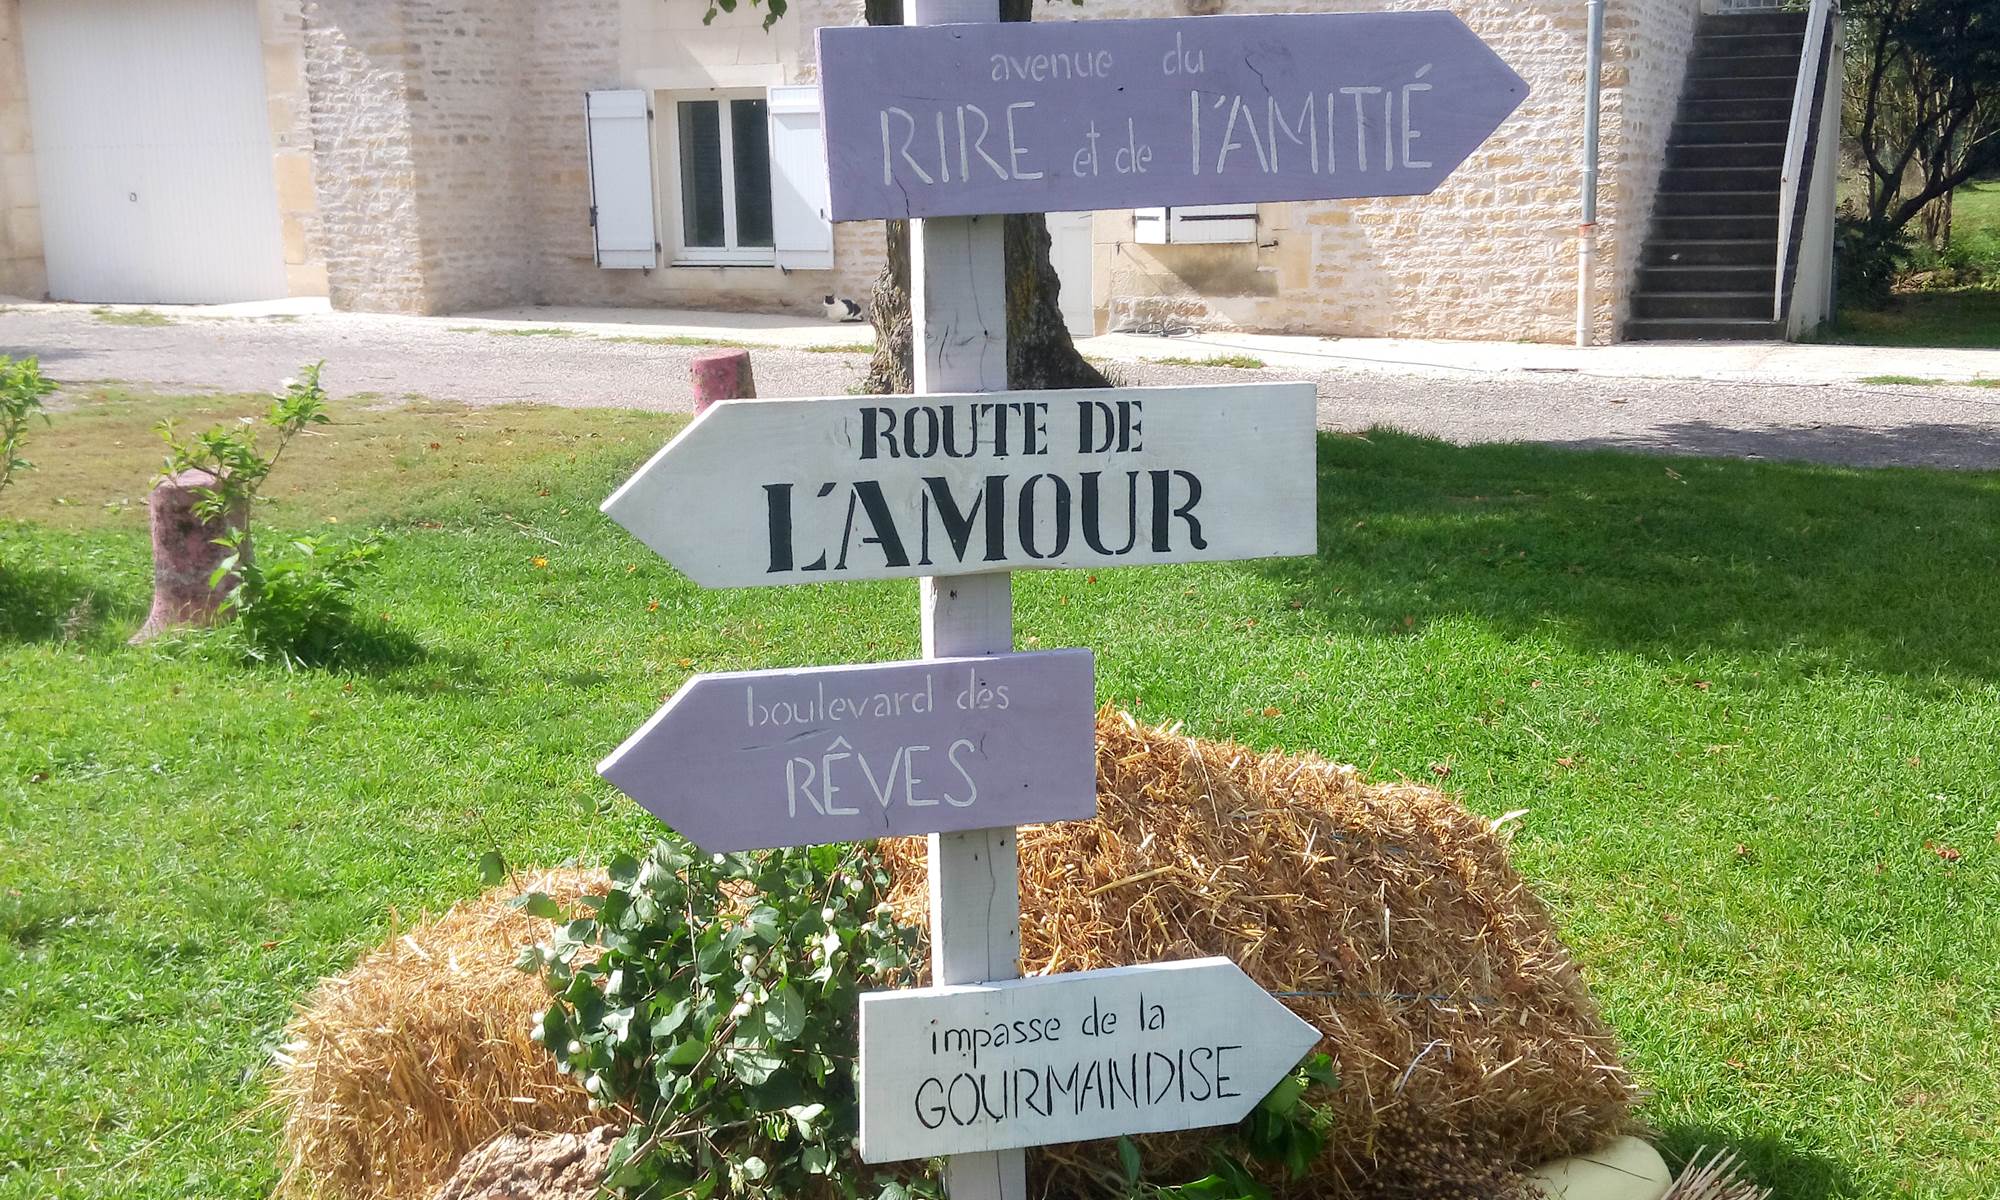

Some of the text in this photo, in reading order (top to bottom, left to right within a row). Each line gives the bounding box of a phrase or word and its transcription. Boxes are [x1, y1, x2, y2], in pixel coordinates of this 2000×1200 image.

[990, 32, 1204, 81] avenue du
[880, 102, 1044, 186] RIRE
[1073, 121, 1099, 178] et
[1115, 117, 1153, 175] de
[859, 401, 1143, 460] ROUTE DE
[747, 668, 1010, 727] boulevard des
[786, 736, 978, 818] RÊVES
[930, 992, 1165, 1068] impasse de la
[914, 1045, 1242, 1130] GOURMANDISE
